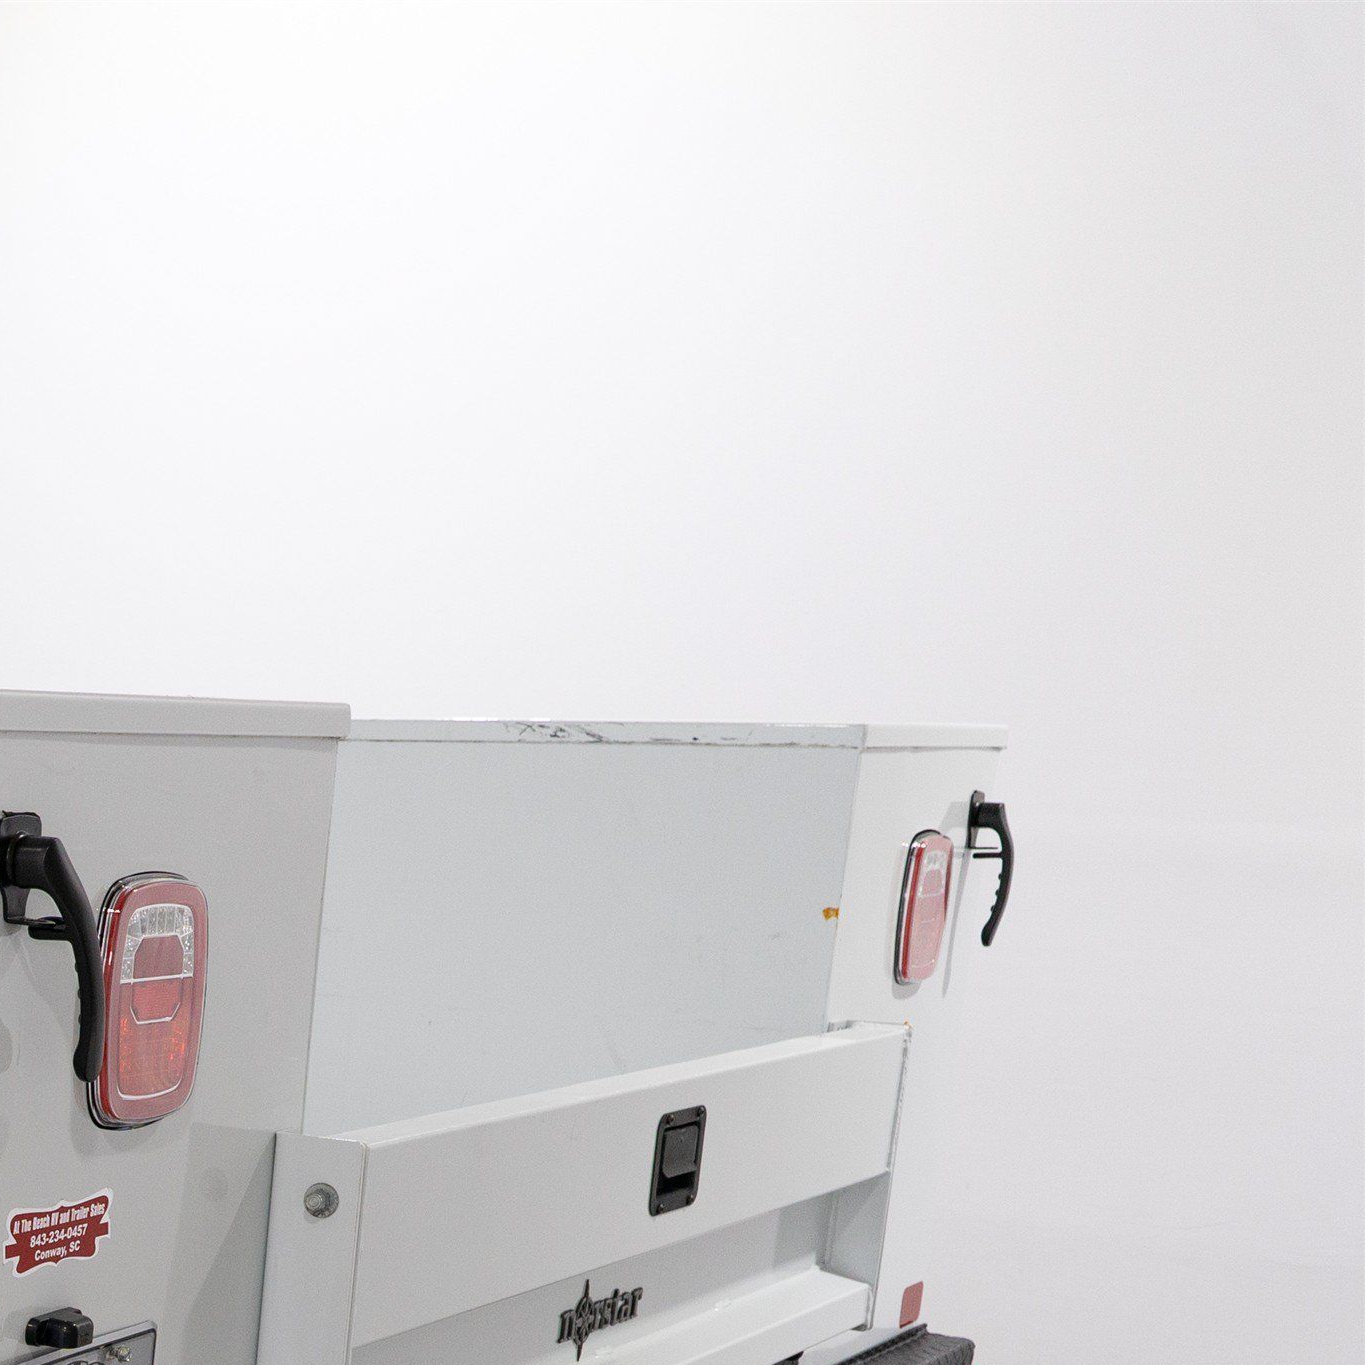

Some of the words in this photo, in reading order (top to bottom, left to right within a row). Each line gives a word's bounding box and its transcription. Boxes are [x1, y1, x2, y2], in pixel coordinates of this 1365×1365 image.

[21, 1219, 31, 1233] The
[33, 1214, 50, 1230] Beach
[59, 1209, 70, 1224] and
[71, 1206, 89, 1222] Trailer
[90, 1203, 105, 1217] Sales
[30, 1223, 88, 1248] 843-234-0457
[35, 1246, 67, 1261] Conway,
[69, 1240, 81, 1253] SC
